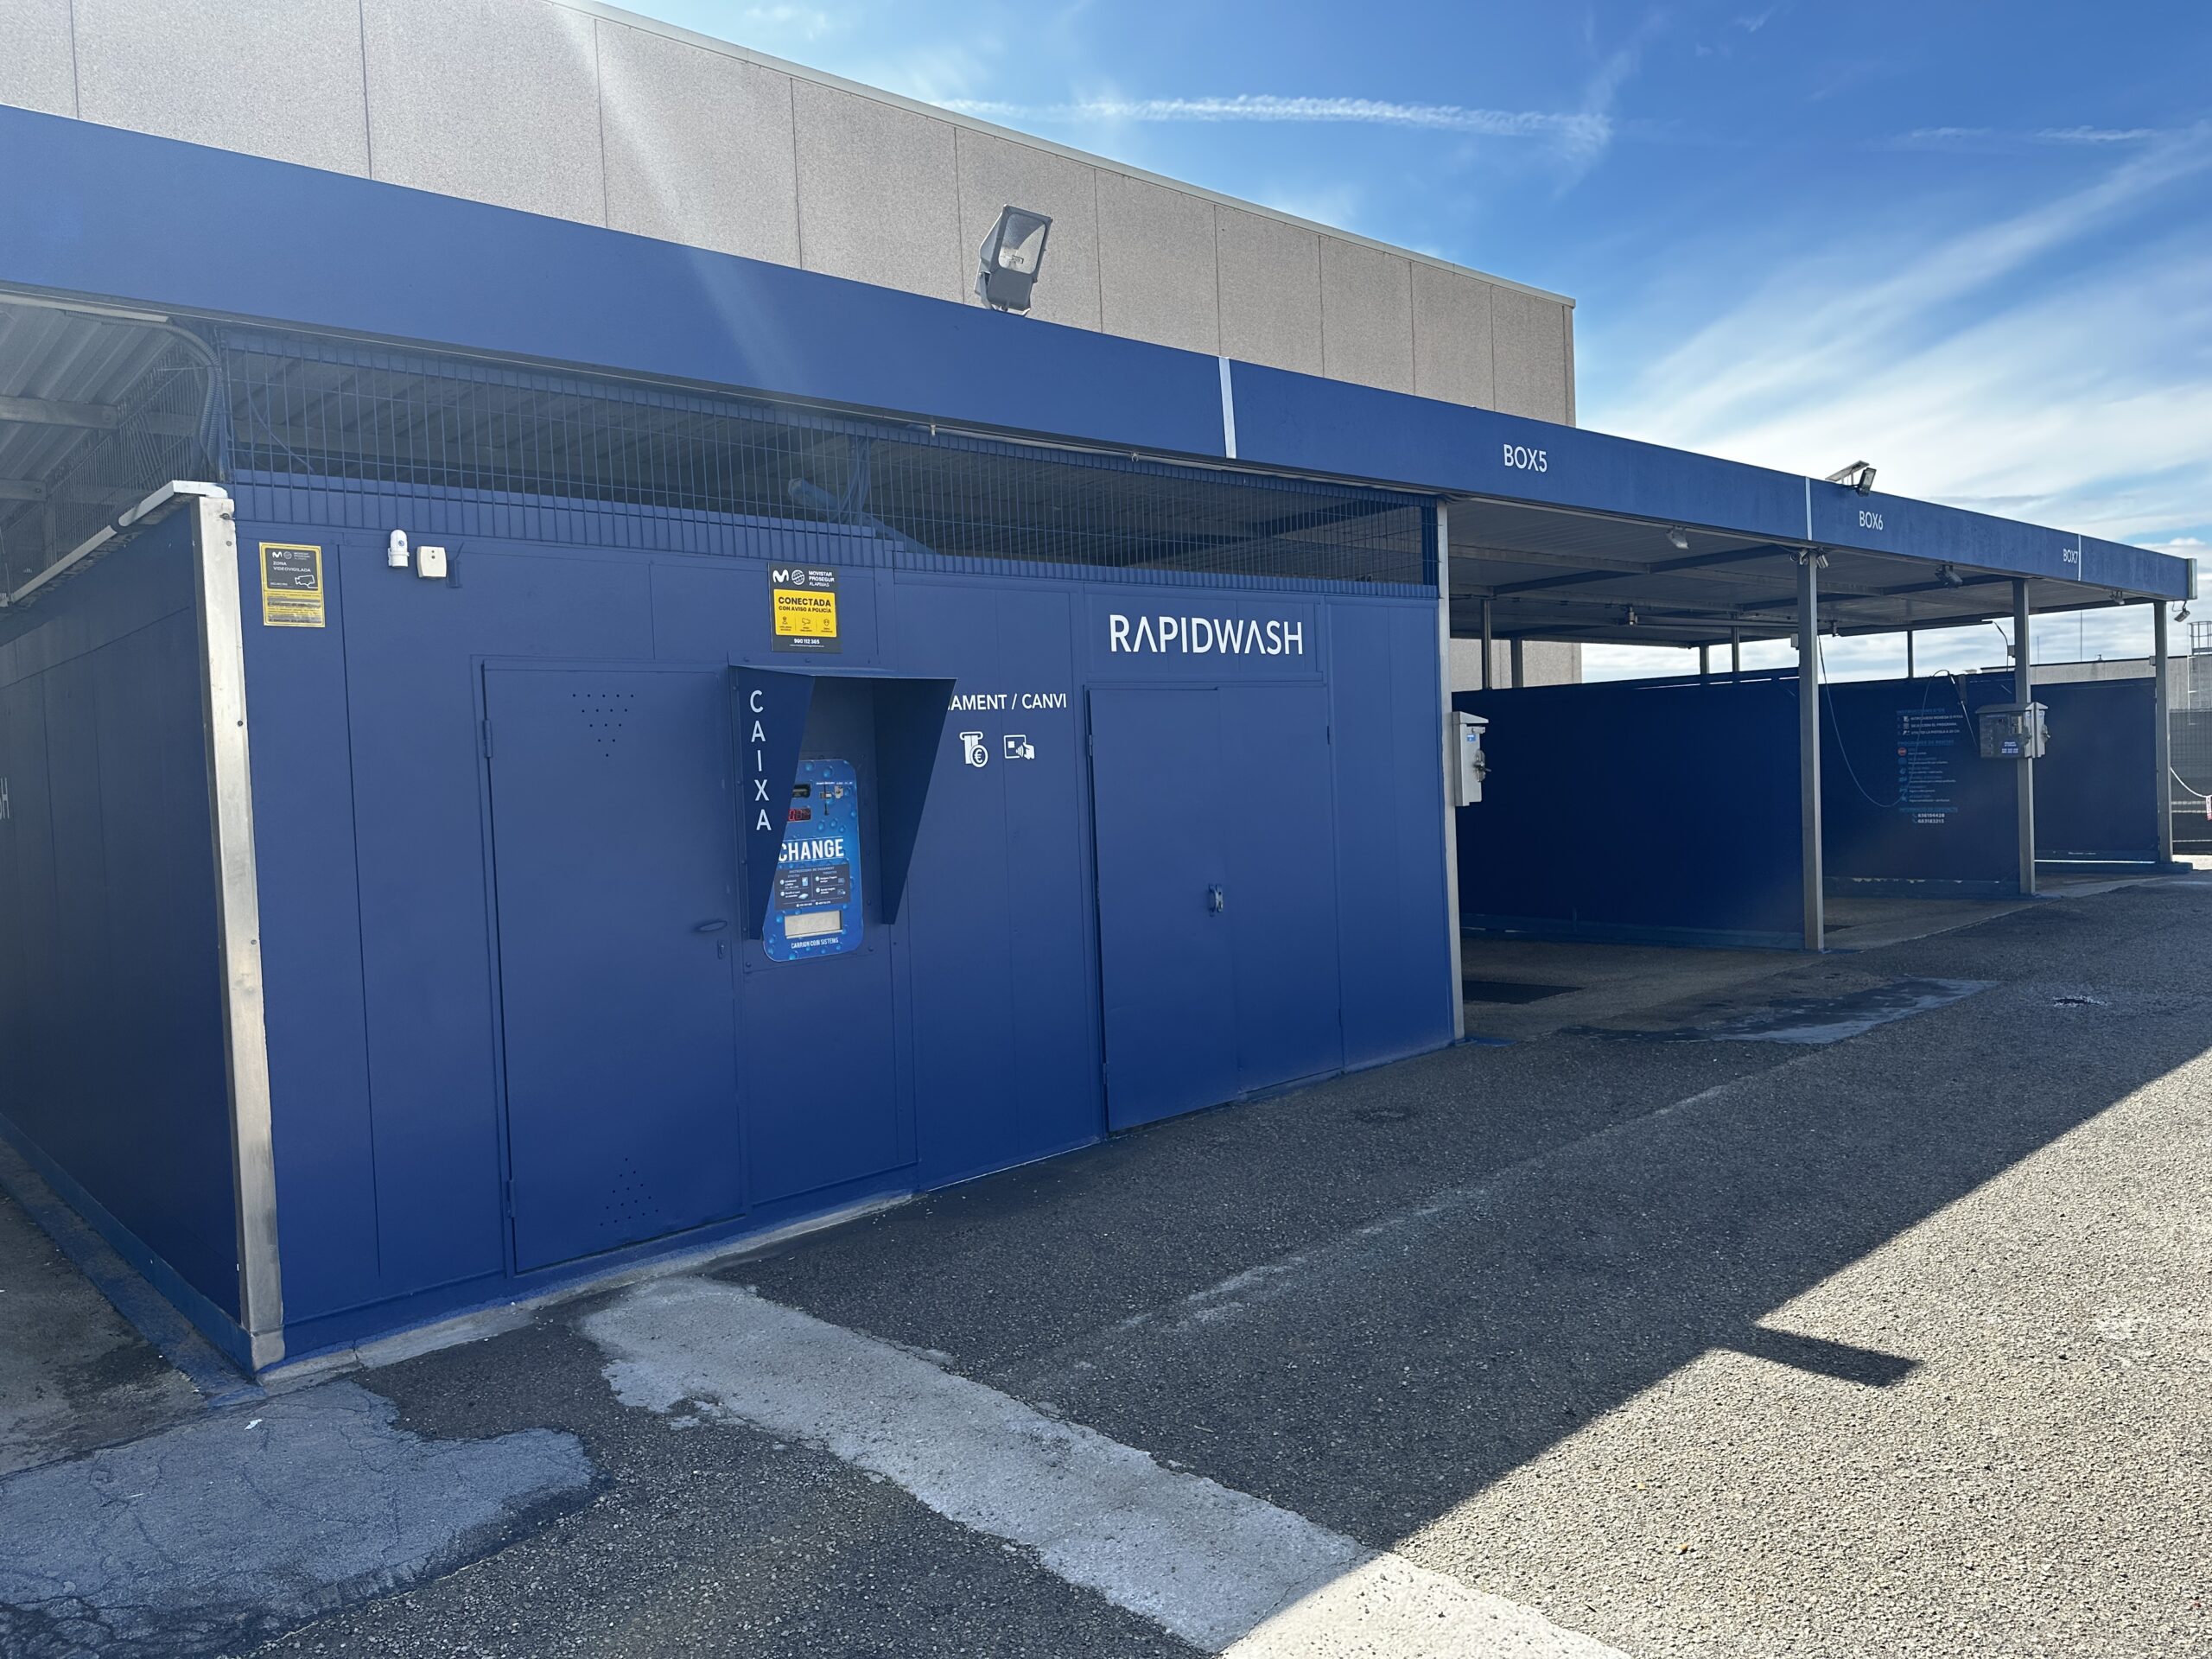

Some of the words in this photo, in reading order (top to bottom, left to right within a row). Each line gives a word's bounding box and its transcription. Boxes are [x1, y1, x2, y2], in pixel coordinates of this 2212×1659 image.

[1503, 444, 1548, 473] BOX5
[1859, 510, 1884, 531] BOX6
[2063, 548, 2078, 564] BOX7
[779, 597, 831, 607] CONECTADA
[1109, 614, 1304, 656] RAPIDWASH
[948, 694, 1007, 711] AMENT
[1021, 693, 1067, 709] CANVI
[750, 690, 772, 831] CAIXA
[779, 838, 845, 863] CHANGE
